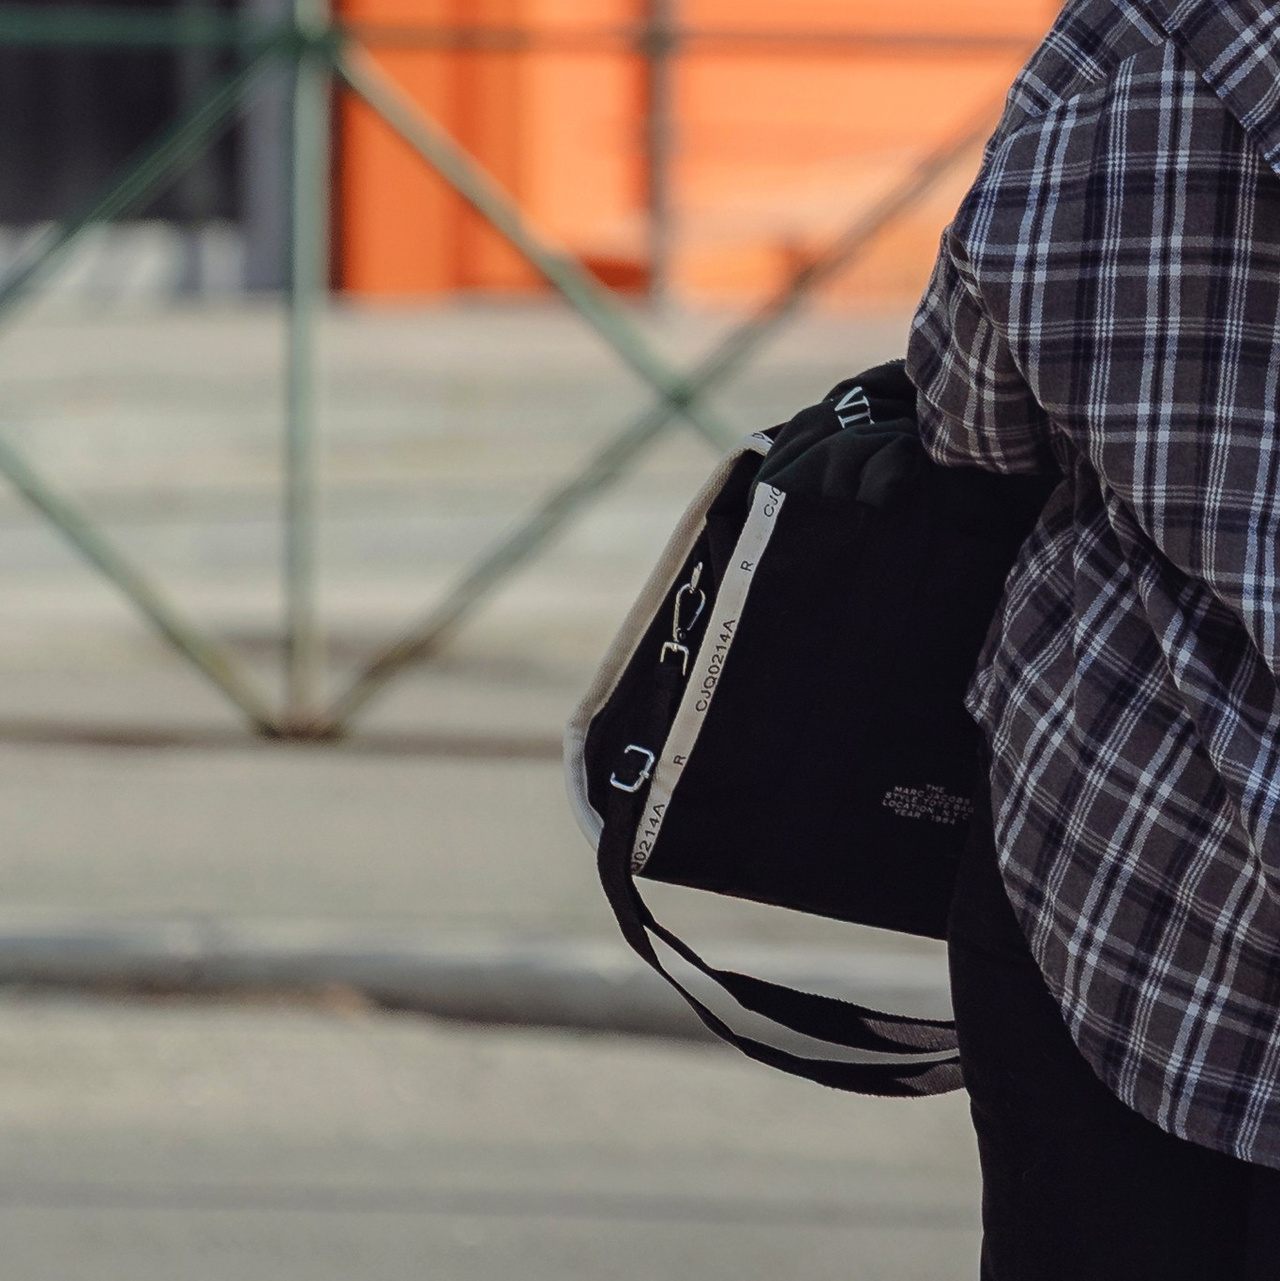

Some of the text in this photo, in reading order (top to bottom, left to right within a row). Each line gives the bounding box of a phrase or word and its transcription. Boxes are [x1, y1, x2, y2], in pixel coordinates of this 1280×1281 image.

[672, 754, 687, 766] R
[695, 619, 736, 713] CJQ0214A
[740, 560, 754, 572] R
[893, 786, 971, 806] MARC JACOBS
[926, 783, 946, 794] THE
[882, 799, 935, 814] LOCATION
[884, 791, 919, 804] STYLE
[923, 798, 951, 810] TOTE
[894, 807, 922, 819] YEAR
